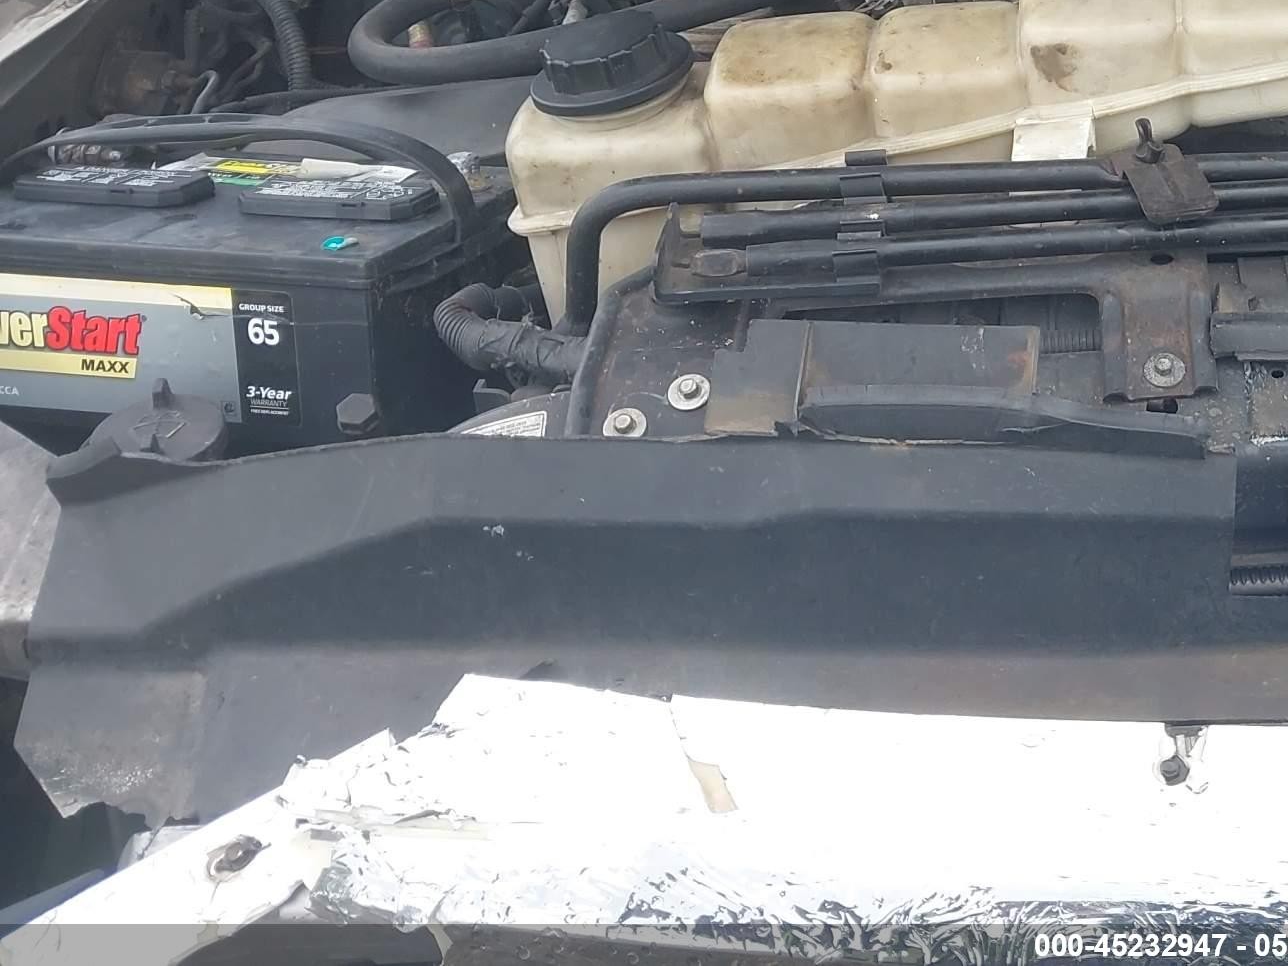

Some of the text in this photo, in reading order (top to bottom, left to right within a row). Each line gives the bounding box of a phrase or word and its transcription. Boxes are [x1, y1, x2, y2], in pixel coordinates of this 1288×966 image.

[247, 318, 280, 345] 65
[81, 359, 129, 373] MAXX
[246, 386, 292, 400] 3-Year
